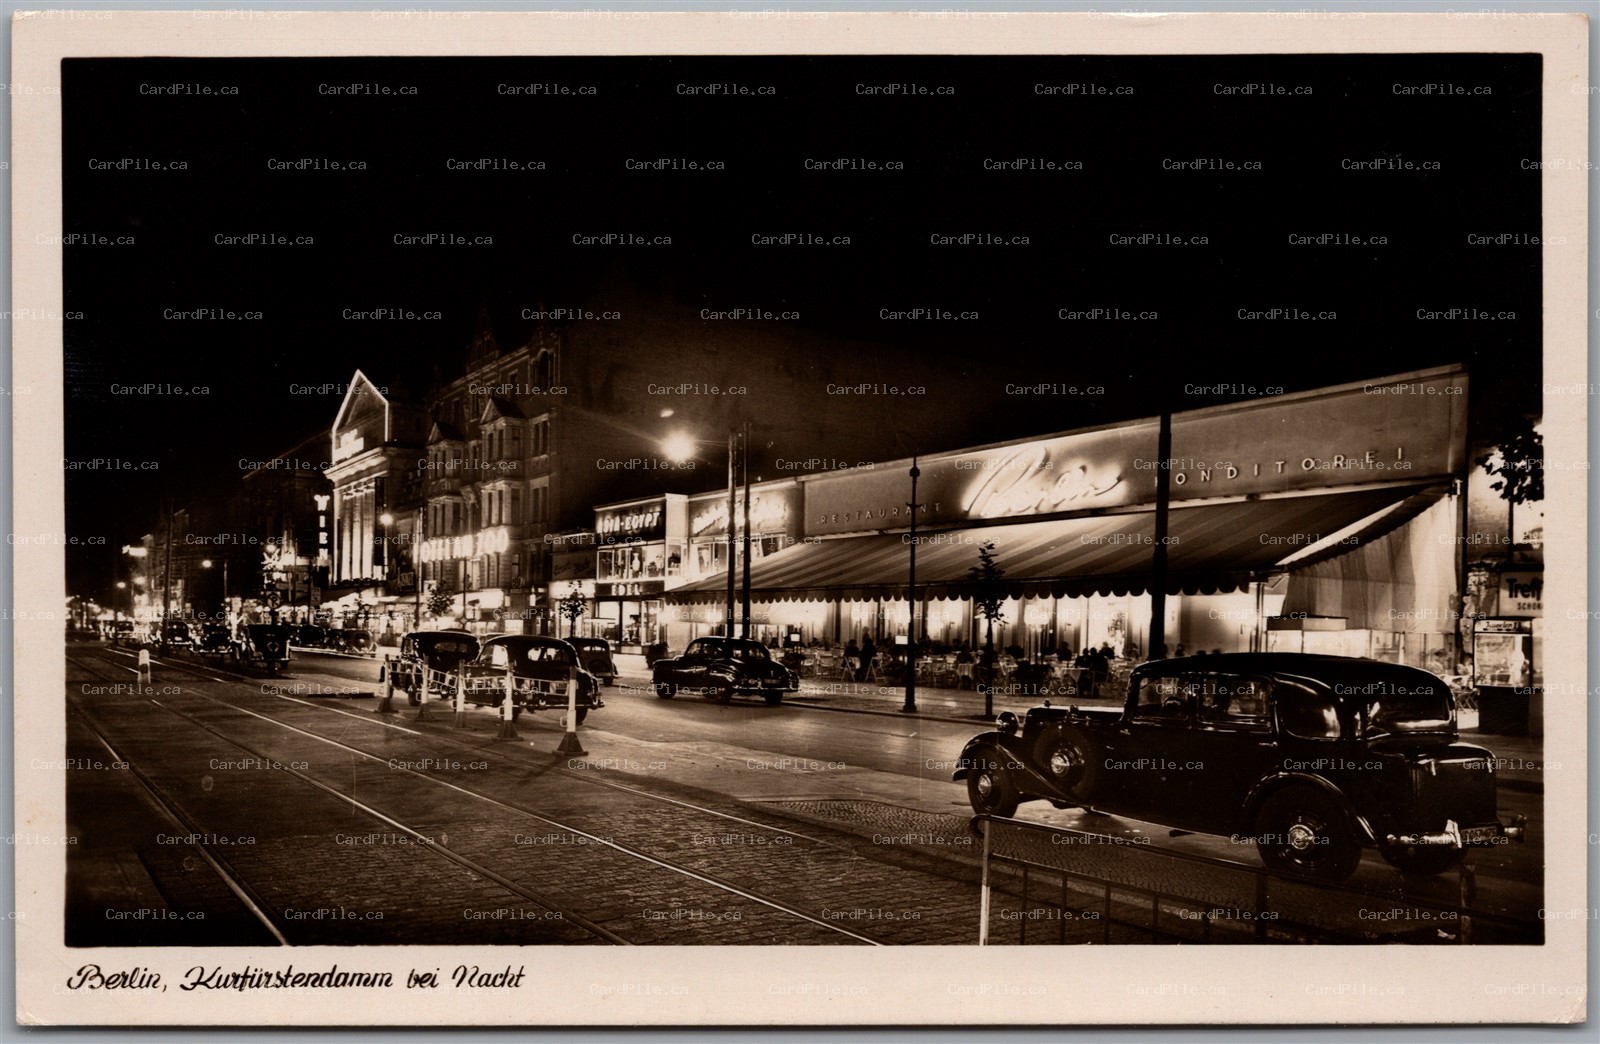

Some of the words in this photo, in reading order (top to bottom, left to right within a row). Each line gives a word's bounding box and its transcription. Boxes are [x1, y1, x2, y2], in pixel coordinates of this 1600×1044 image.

[1155, 447, 1402, 488] ONDITOREI
[820, 503, 940, 523] RESTAURANT
[611, 584, 641, 596] EDEL
